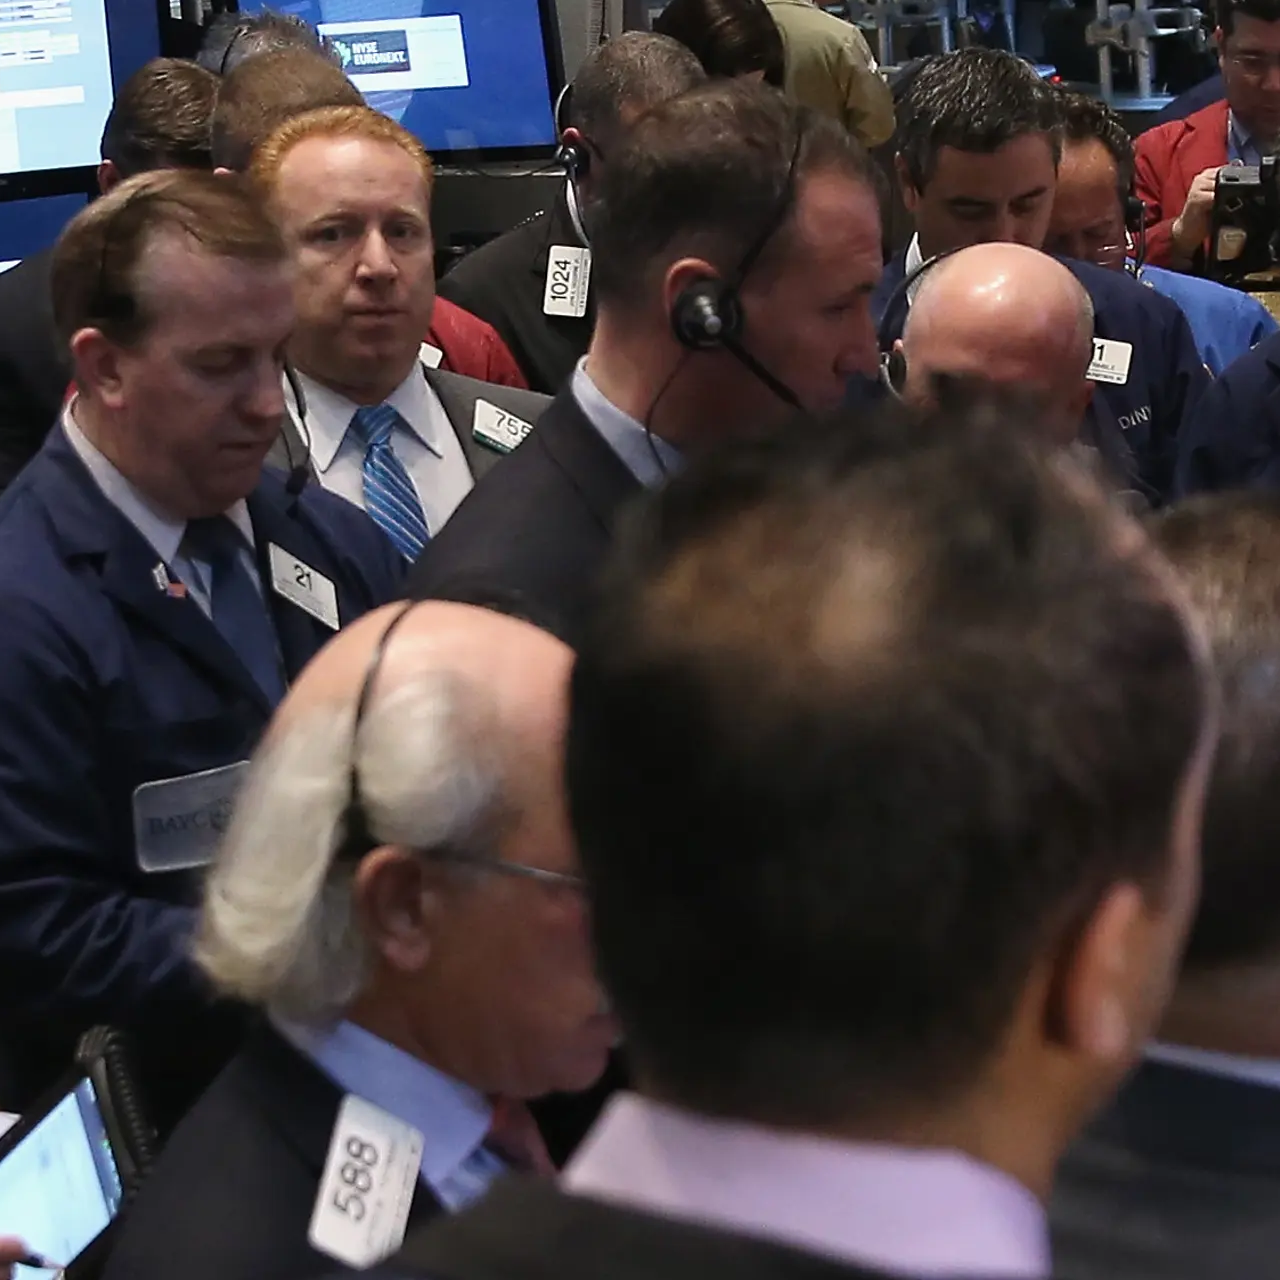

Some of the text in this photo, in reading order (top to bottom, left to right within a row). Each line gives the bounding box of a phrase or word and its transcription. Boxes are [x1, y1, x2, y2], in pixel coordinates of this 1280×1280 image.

[352, 42, 378, 53] NYSE
[551, 260, 570, 301] 1024
[294, 563, 312, 592] 21
[333, 1136, 378, 1221] 588
